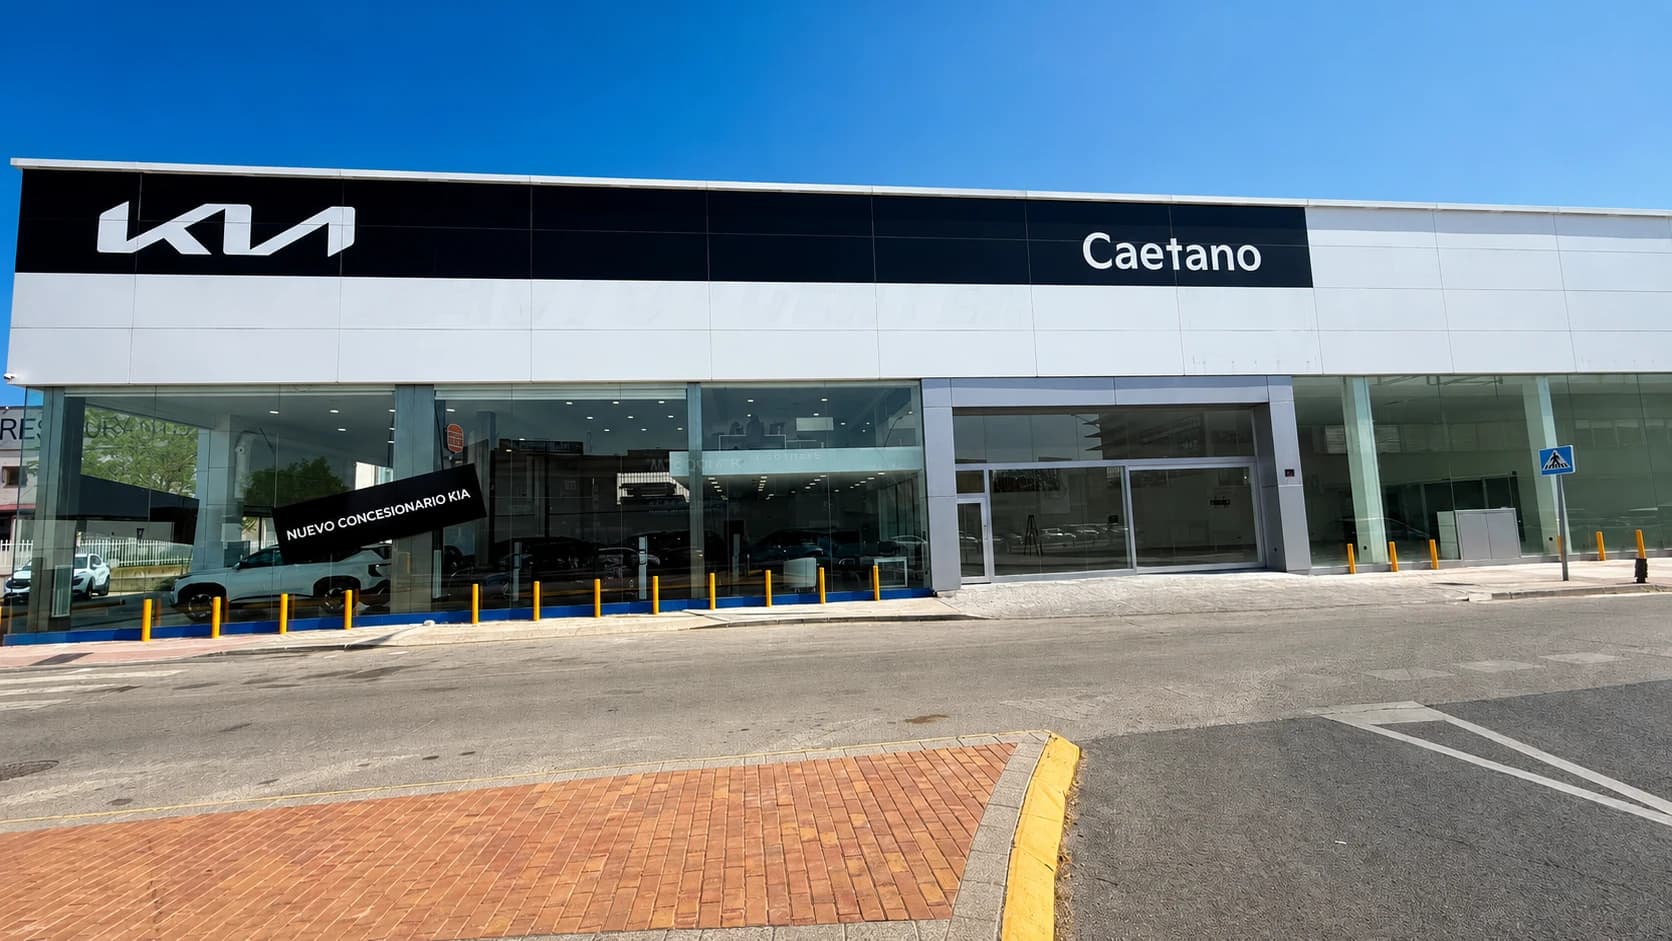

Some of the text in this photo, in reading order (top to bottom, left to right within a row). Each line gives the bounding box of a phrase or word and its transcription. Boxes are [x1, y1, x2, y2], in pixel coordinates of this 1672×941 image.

[97, 201, 355, 257] KIA
[1082, 232, 1262, 271] Caetano
[286, 488, 471, 541] NUEVO CONCESIONARIO KIA
